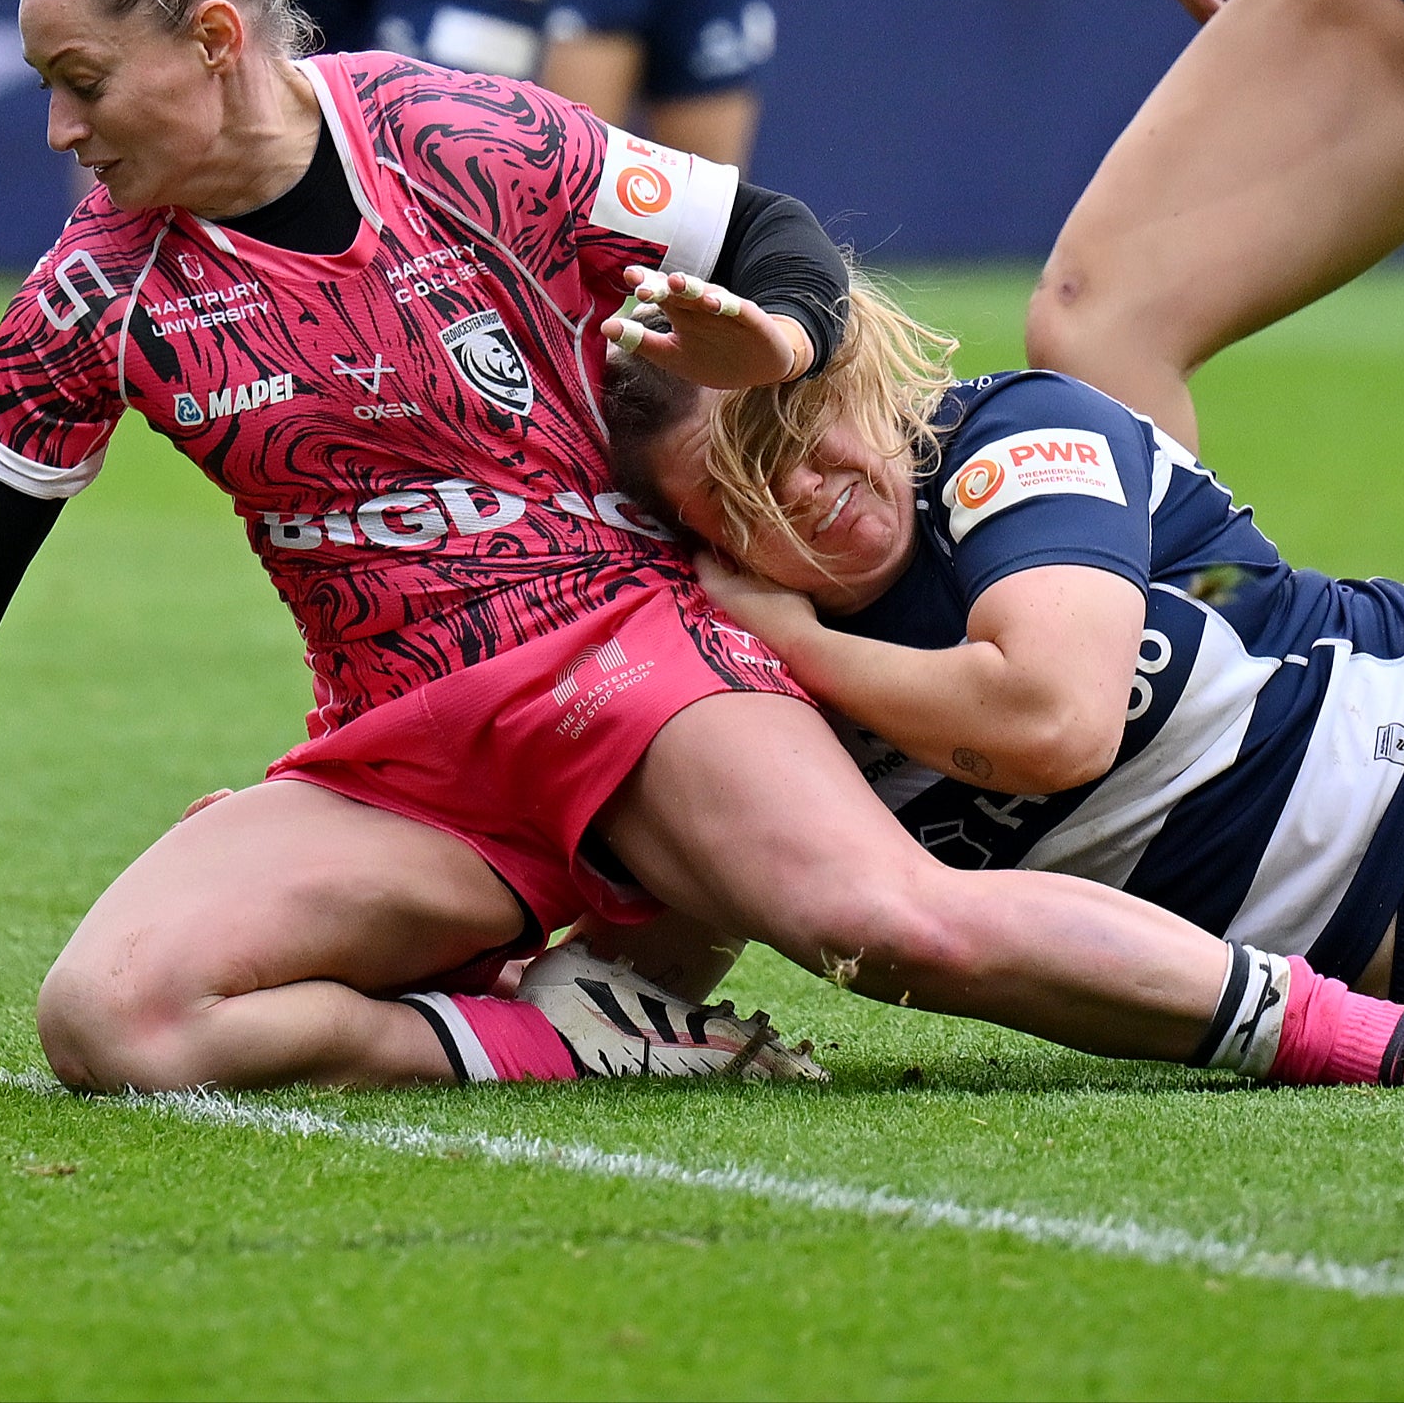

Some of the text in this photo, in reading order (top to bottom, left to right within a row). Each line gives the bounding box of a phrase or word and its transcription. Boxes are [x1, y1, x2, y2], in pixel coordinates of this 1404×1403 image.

[145, 281, 260, 318] HARTPURY
[152, 301, 269, 337] UNIVERSITY
[442, 316, 482, 345] GLOUCESTER
[209, 373, 294, 419] MAPEI
[353, 402, 423, 420] OXEN
[1009, 442, 1101, 467] PWR
[1017, 467, 1086, 480] PREMIERSHIP
[1020, 476, 1073, 487] WOMEN'S
[556, 660, 655, 735] THE PLASTERERS
[570, 670, 650, 740] ONE STOP SHOP
